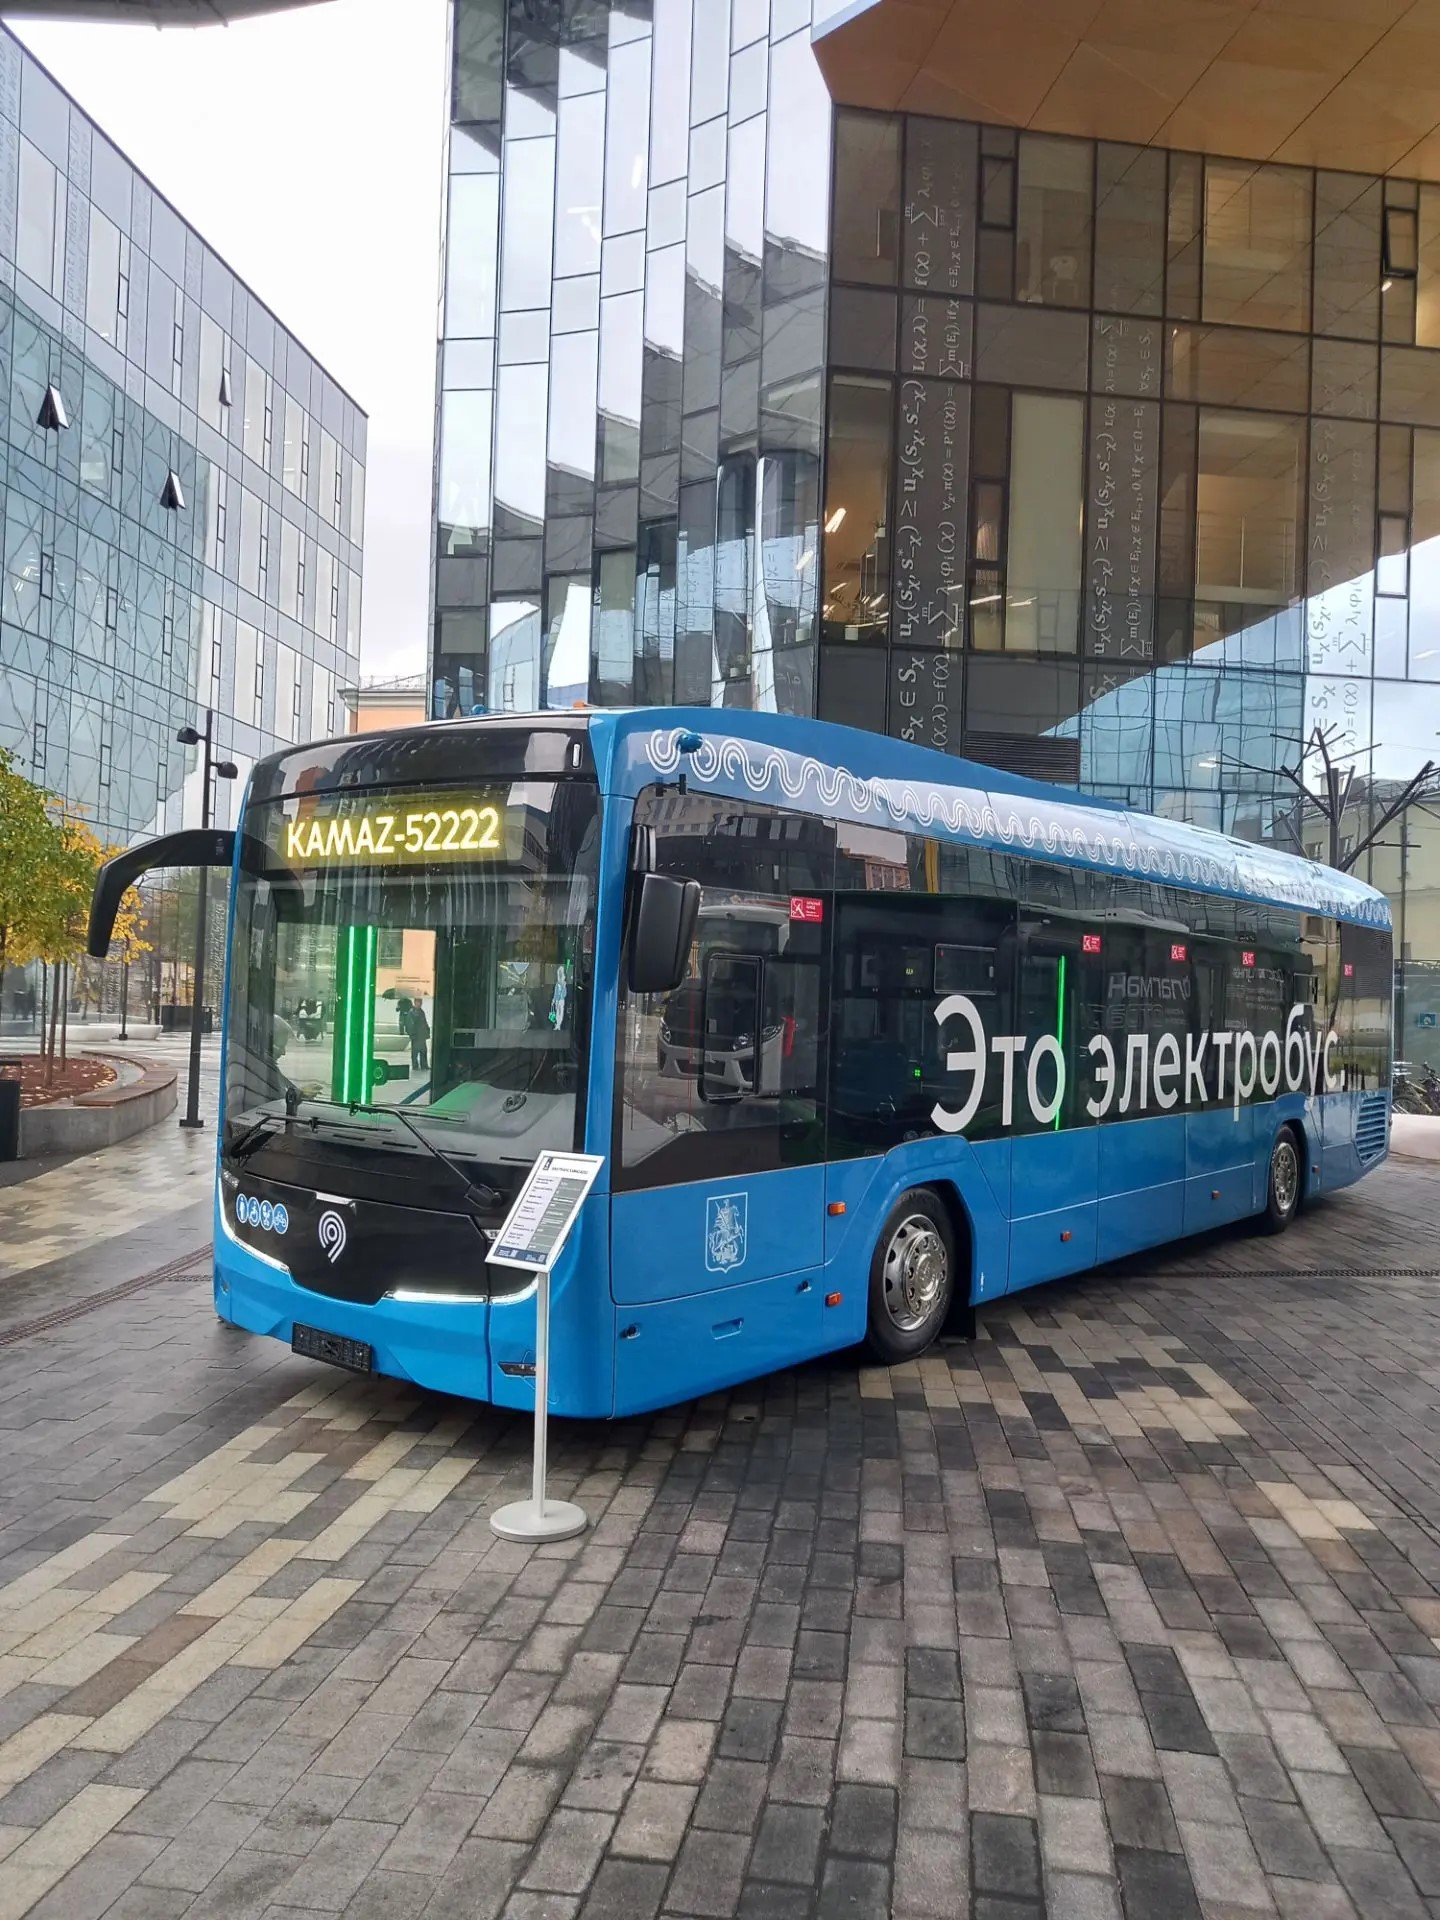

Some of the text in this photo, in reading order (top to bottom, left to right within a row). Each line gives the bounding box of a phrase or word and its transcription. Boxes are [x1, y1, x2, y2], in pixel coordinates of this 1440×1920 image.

[287, 807, 500, 858] KAMAZ-52222
[930, 994, 1346, 1133] Это электробус.
